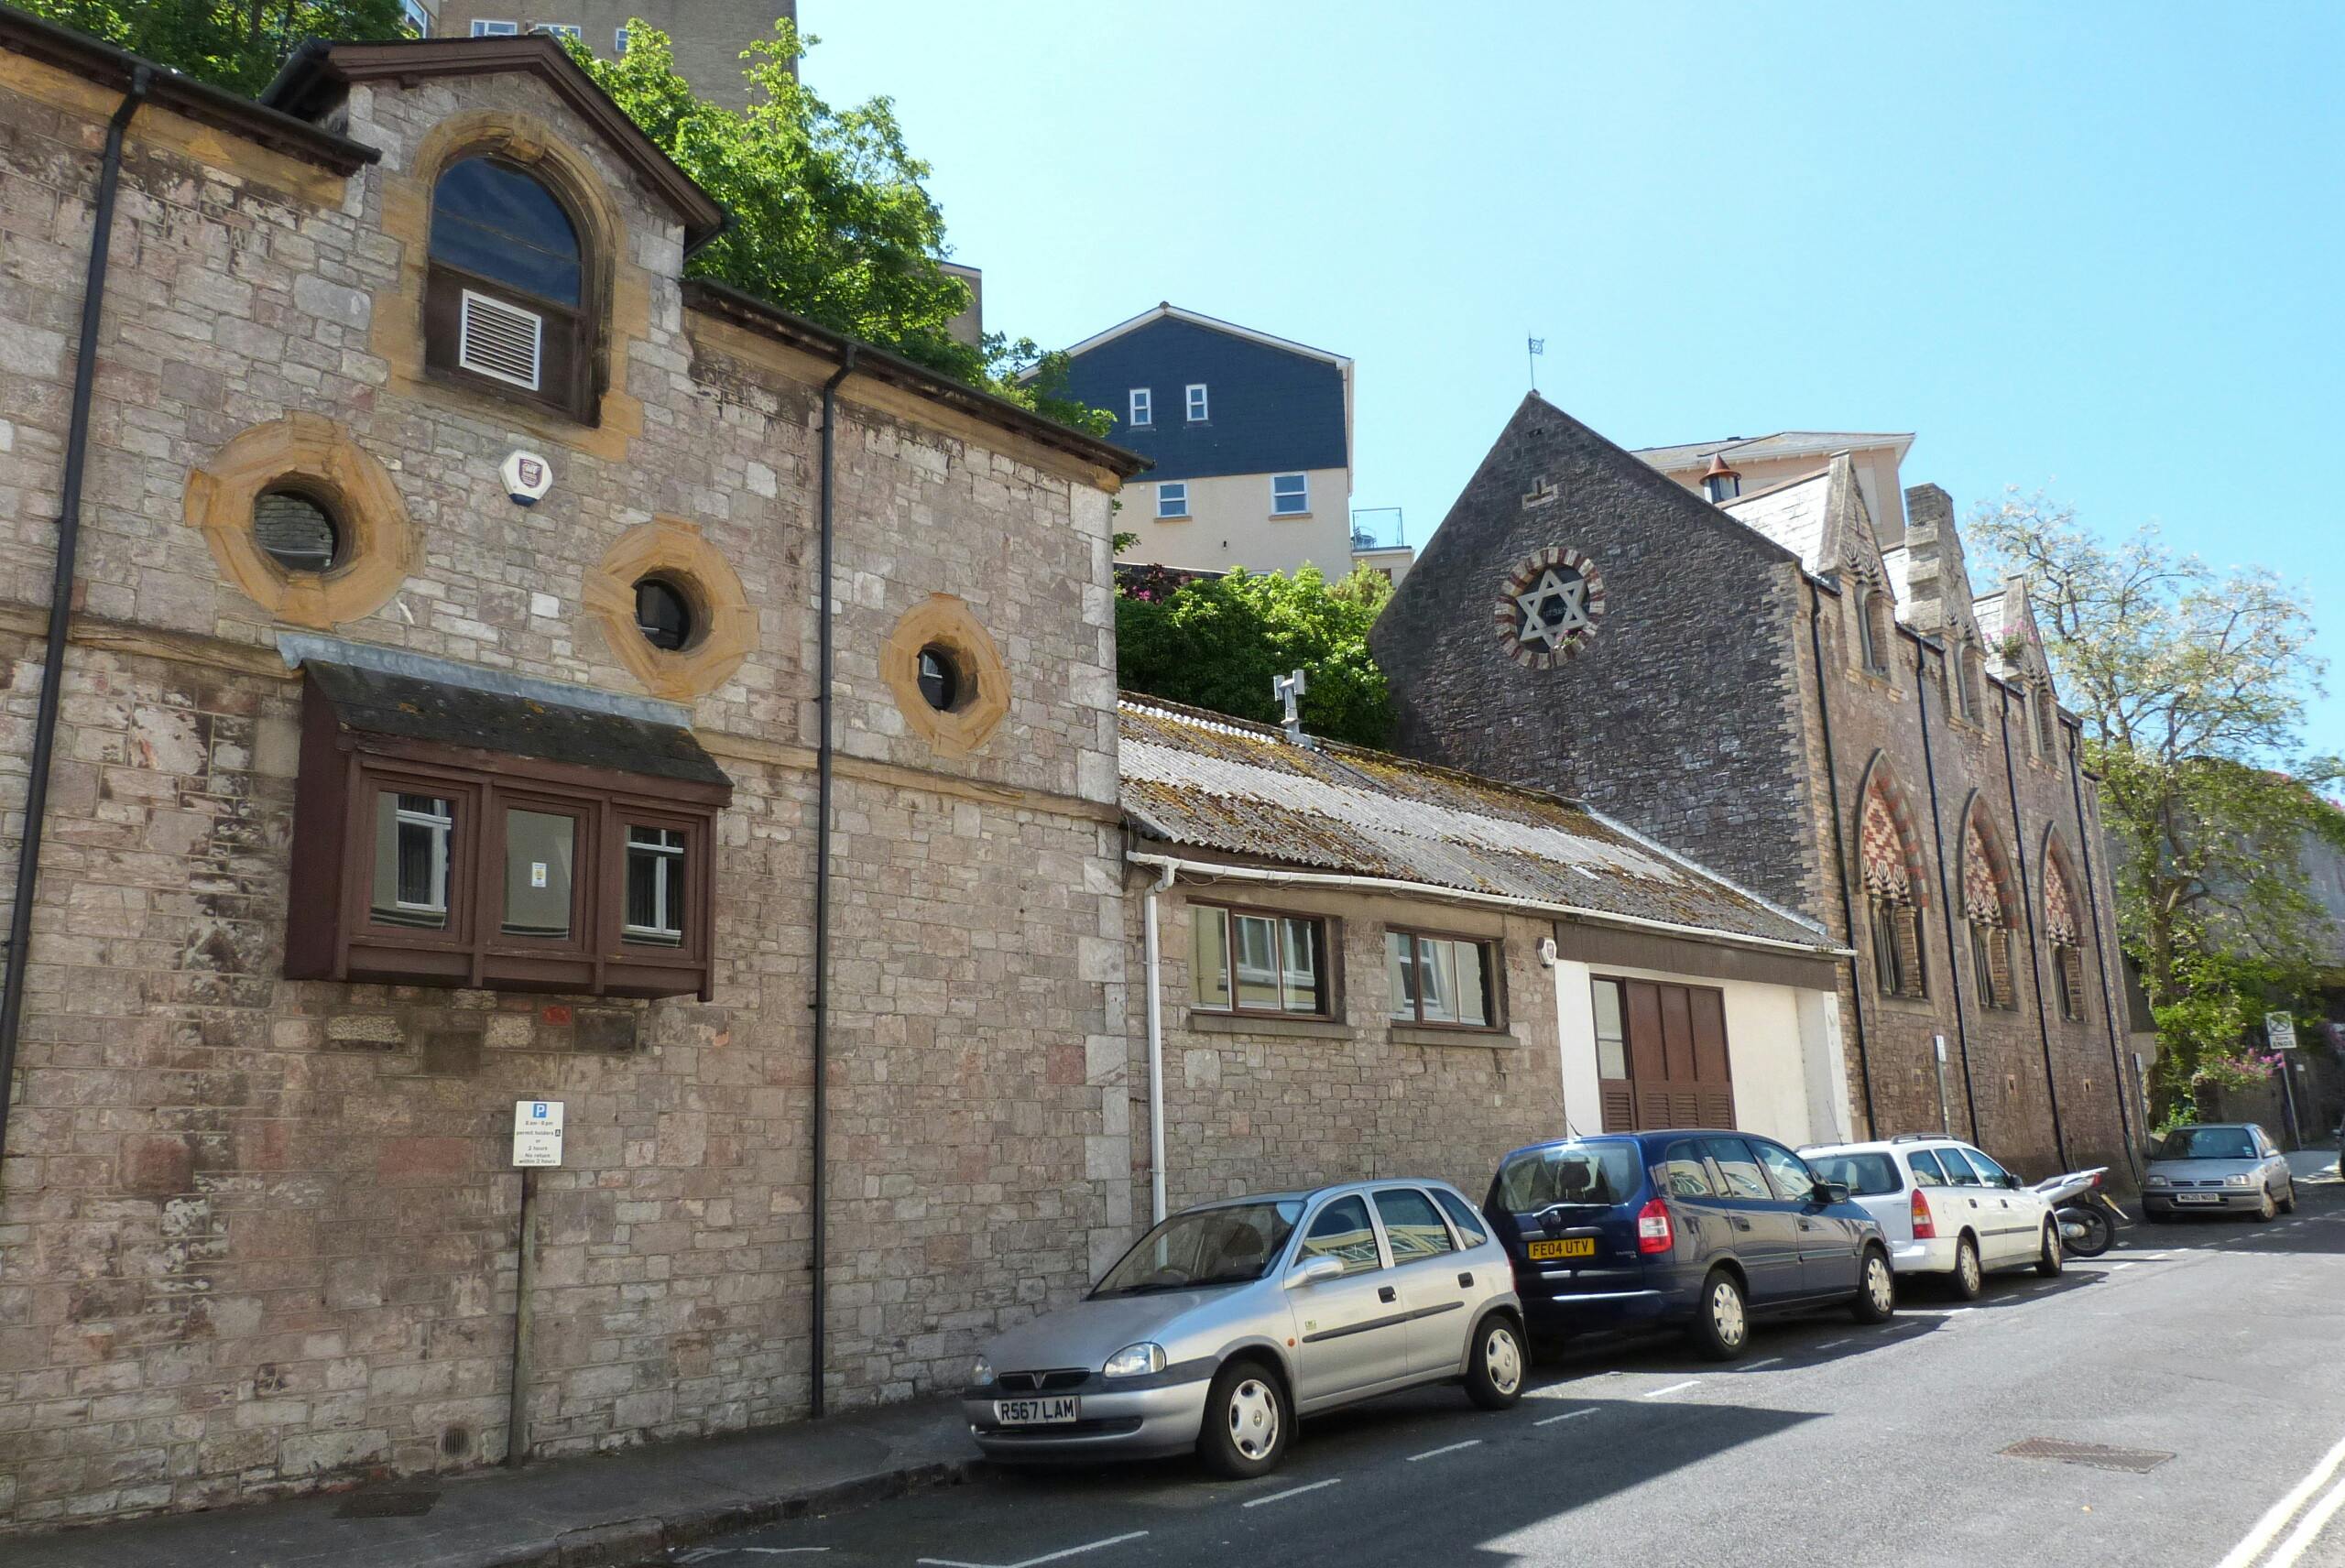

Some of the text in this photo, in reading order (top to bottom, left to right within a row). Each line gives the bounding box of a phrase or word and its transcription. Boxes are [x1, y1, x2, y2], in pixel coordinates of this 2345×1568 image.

[536, 1105, 545, 1116] P
[1532, 1240, 1589, 1257] FE04 UTV
[1000, 1399, 1074, 1421] R567 LAM
